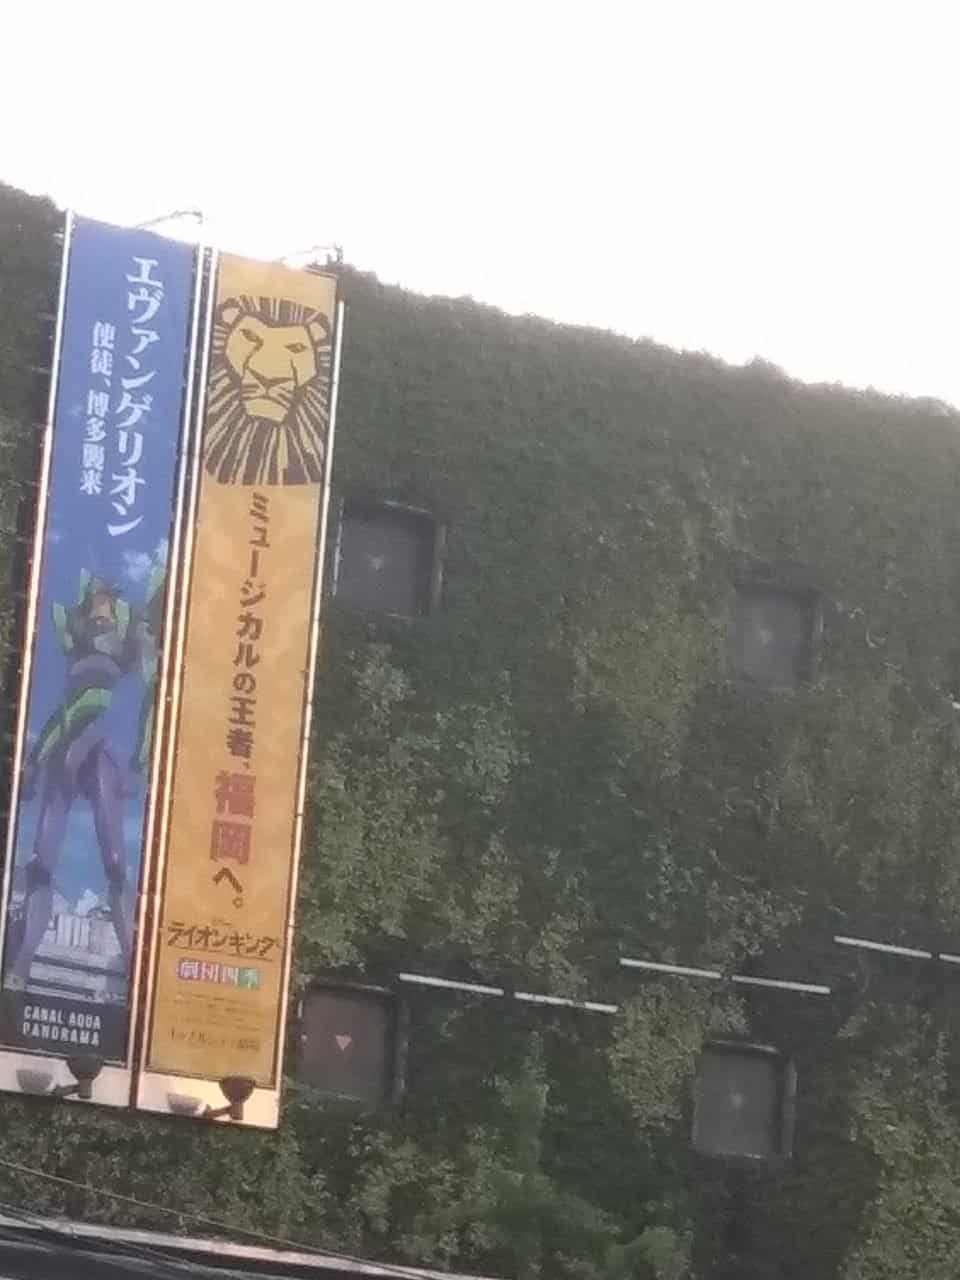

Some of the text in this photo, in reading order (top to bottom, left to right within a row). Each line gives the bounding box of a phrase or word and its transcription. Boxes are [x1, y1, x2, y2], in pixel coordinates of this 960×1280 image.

[107, 255, 165, 537] エヴァンゲリオン
[24, 1005, 101, 1030] CANAL AQUA
[23, 1021, 100, 1047] PANORAMA
